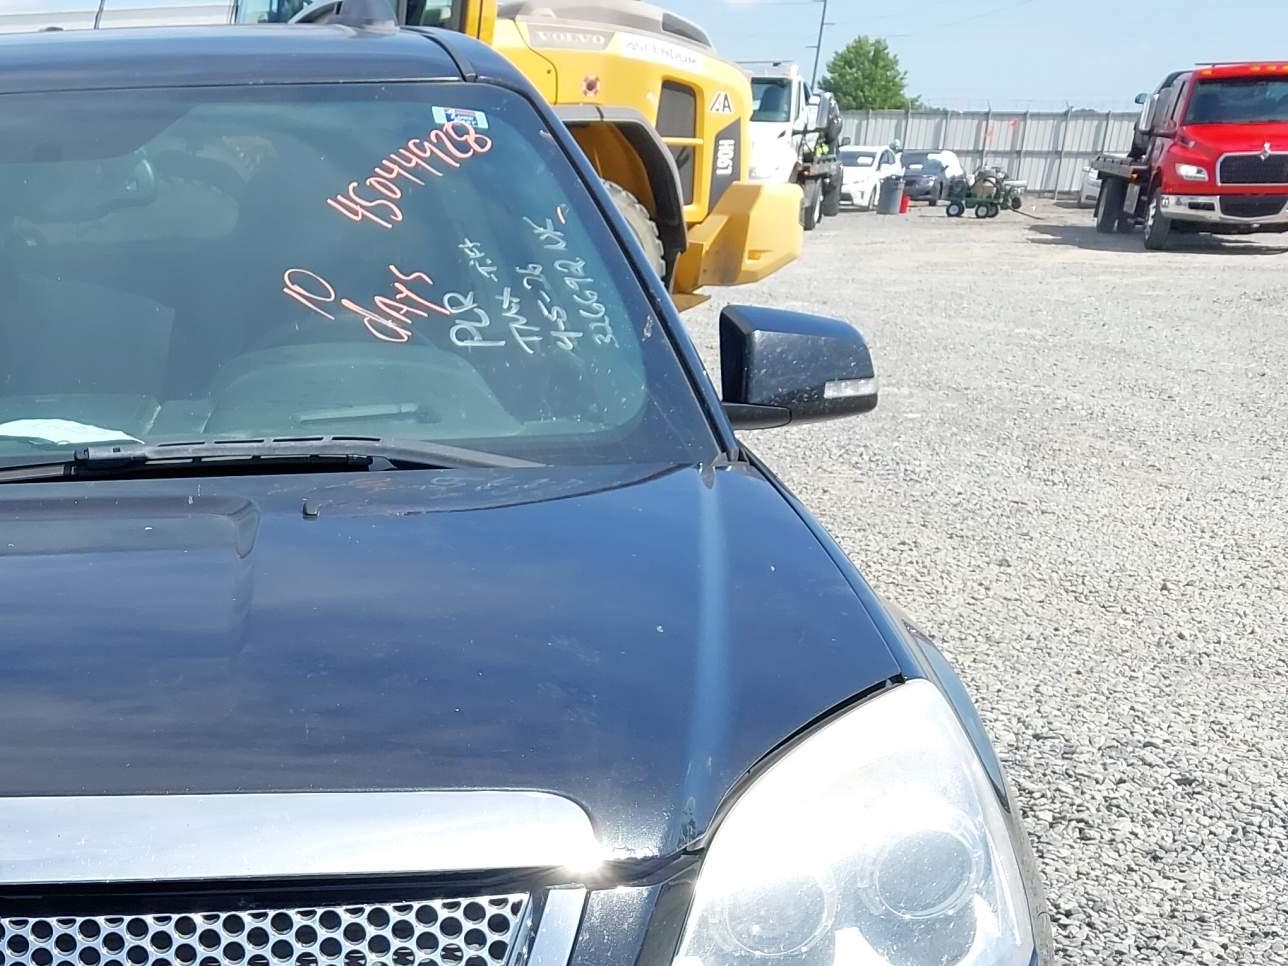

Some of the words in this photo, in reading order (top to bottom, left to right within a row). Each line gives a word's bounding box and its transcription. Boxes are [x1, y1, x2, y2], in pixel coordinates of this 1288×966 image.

[536, 31, 606, 45] VOLVO
[326, 119, 493, 228] 45044928
[715, 139, 736, 176] L90H
